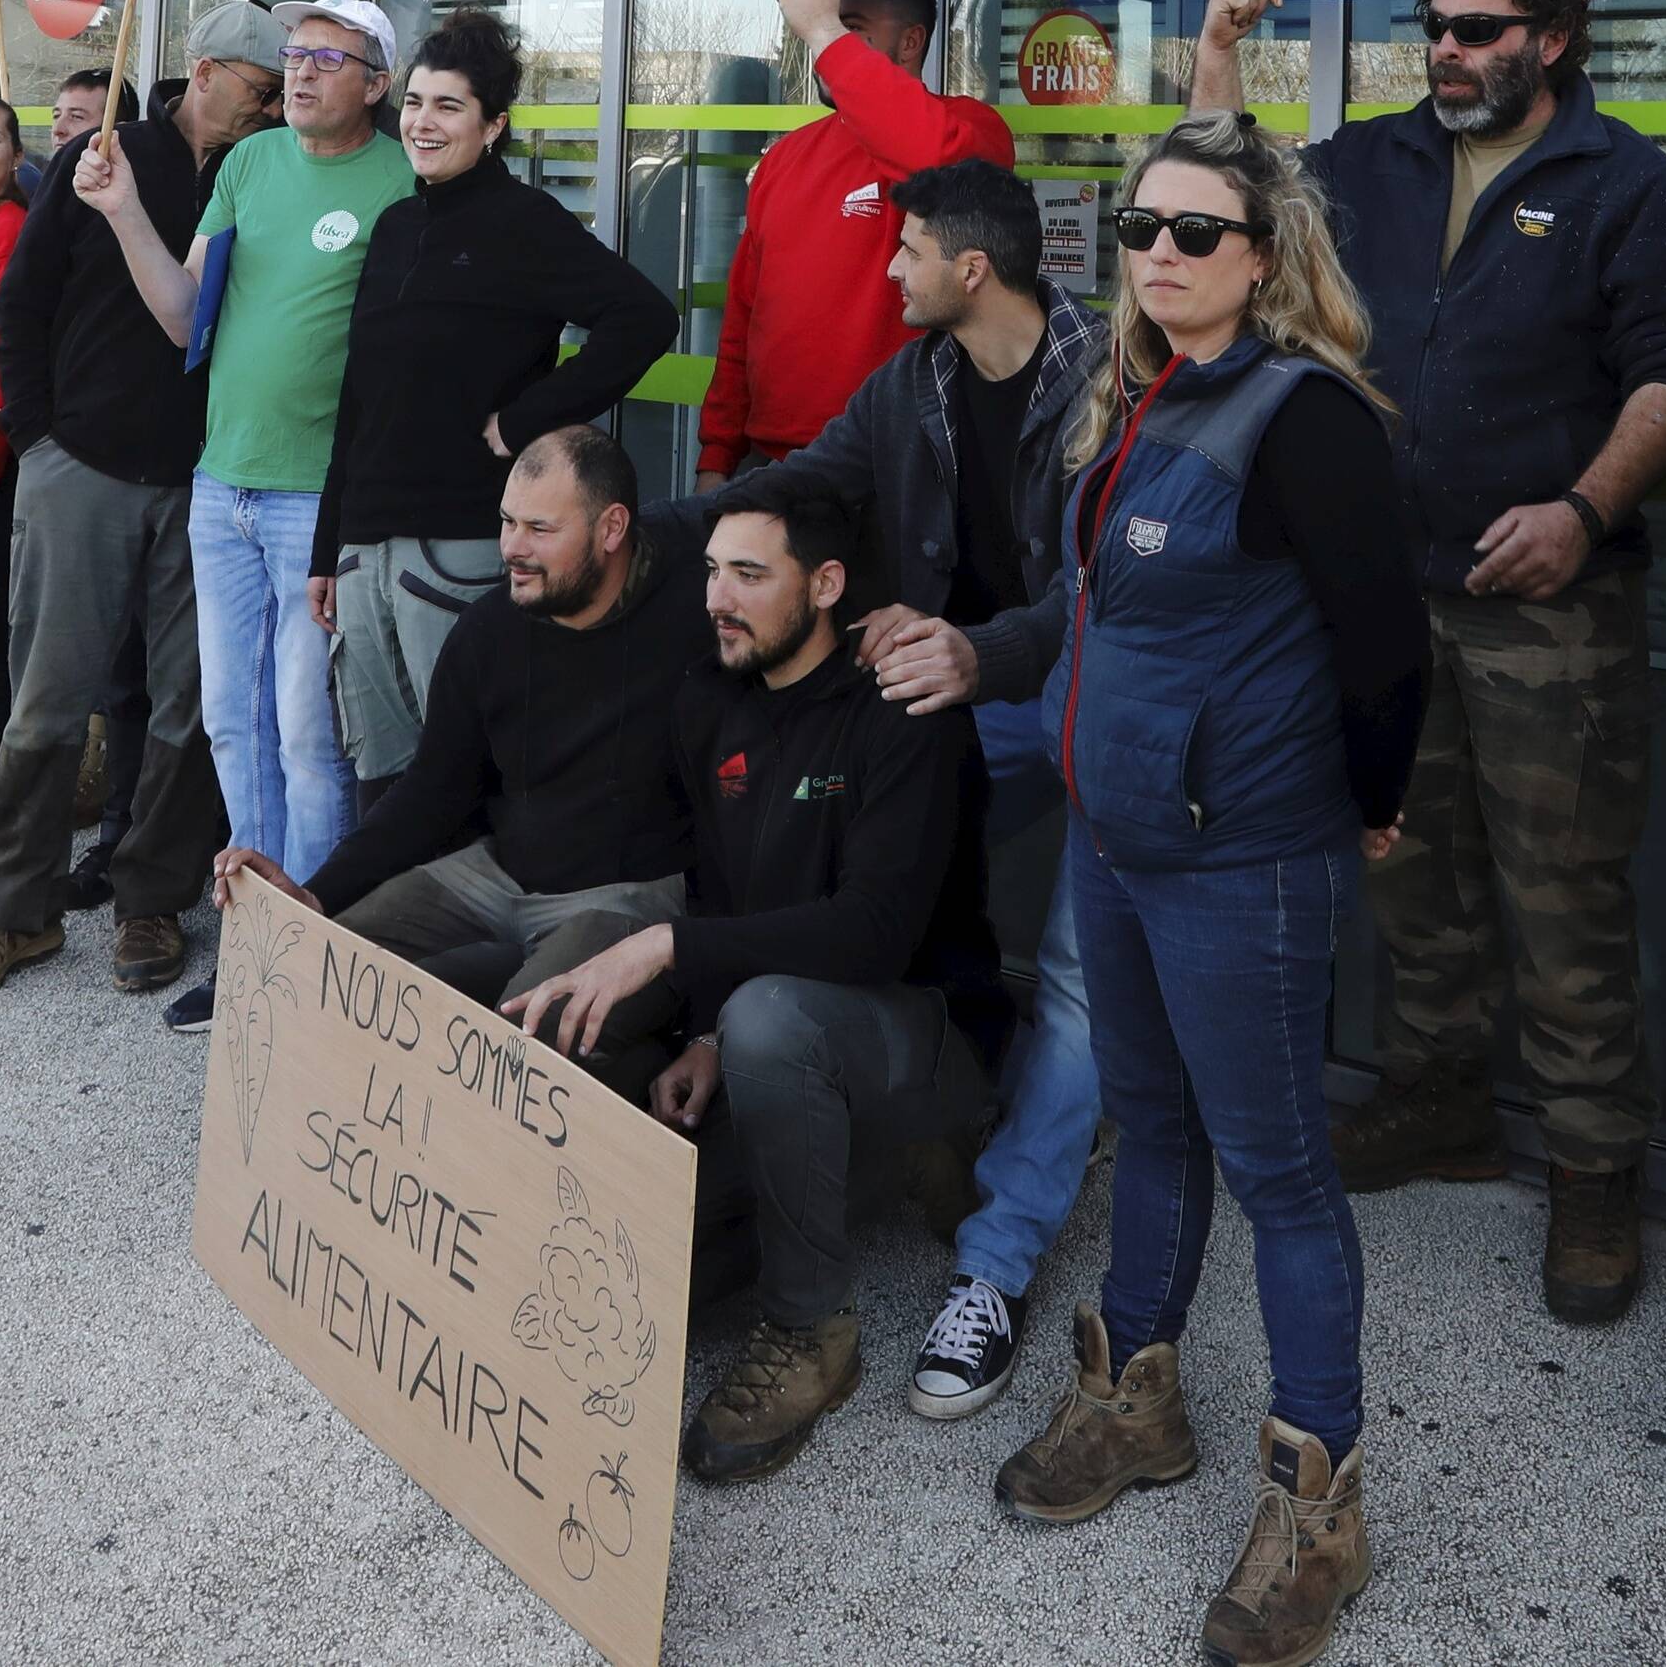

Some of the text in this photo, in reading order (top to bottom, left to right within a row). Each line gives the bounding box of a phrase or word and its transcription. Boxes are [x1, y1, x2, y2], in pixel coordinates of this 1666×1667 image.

[1031, 63, 1102, 92] FRAIS
[1518, 208, 1556, 222] RACINE
[320, 939, 571, 1148] NOUS SOMMES
[363, 1062, 406, 1147] LA
[296, 1109, 497, 1294] SÉCURITÉ
[241, 1188, 550, 1502] ALIMENTAIRE
